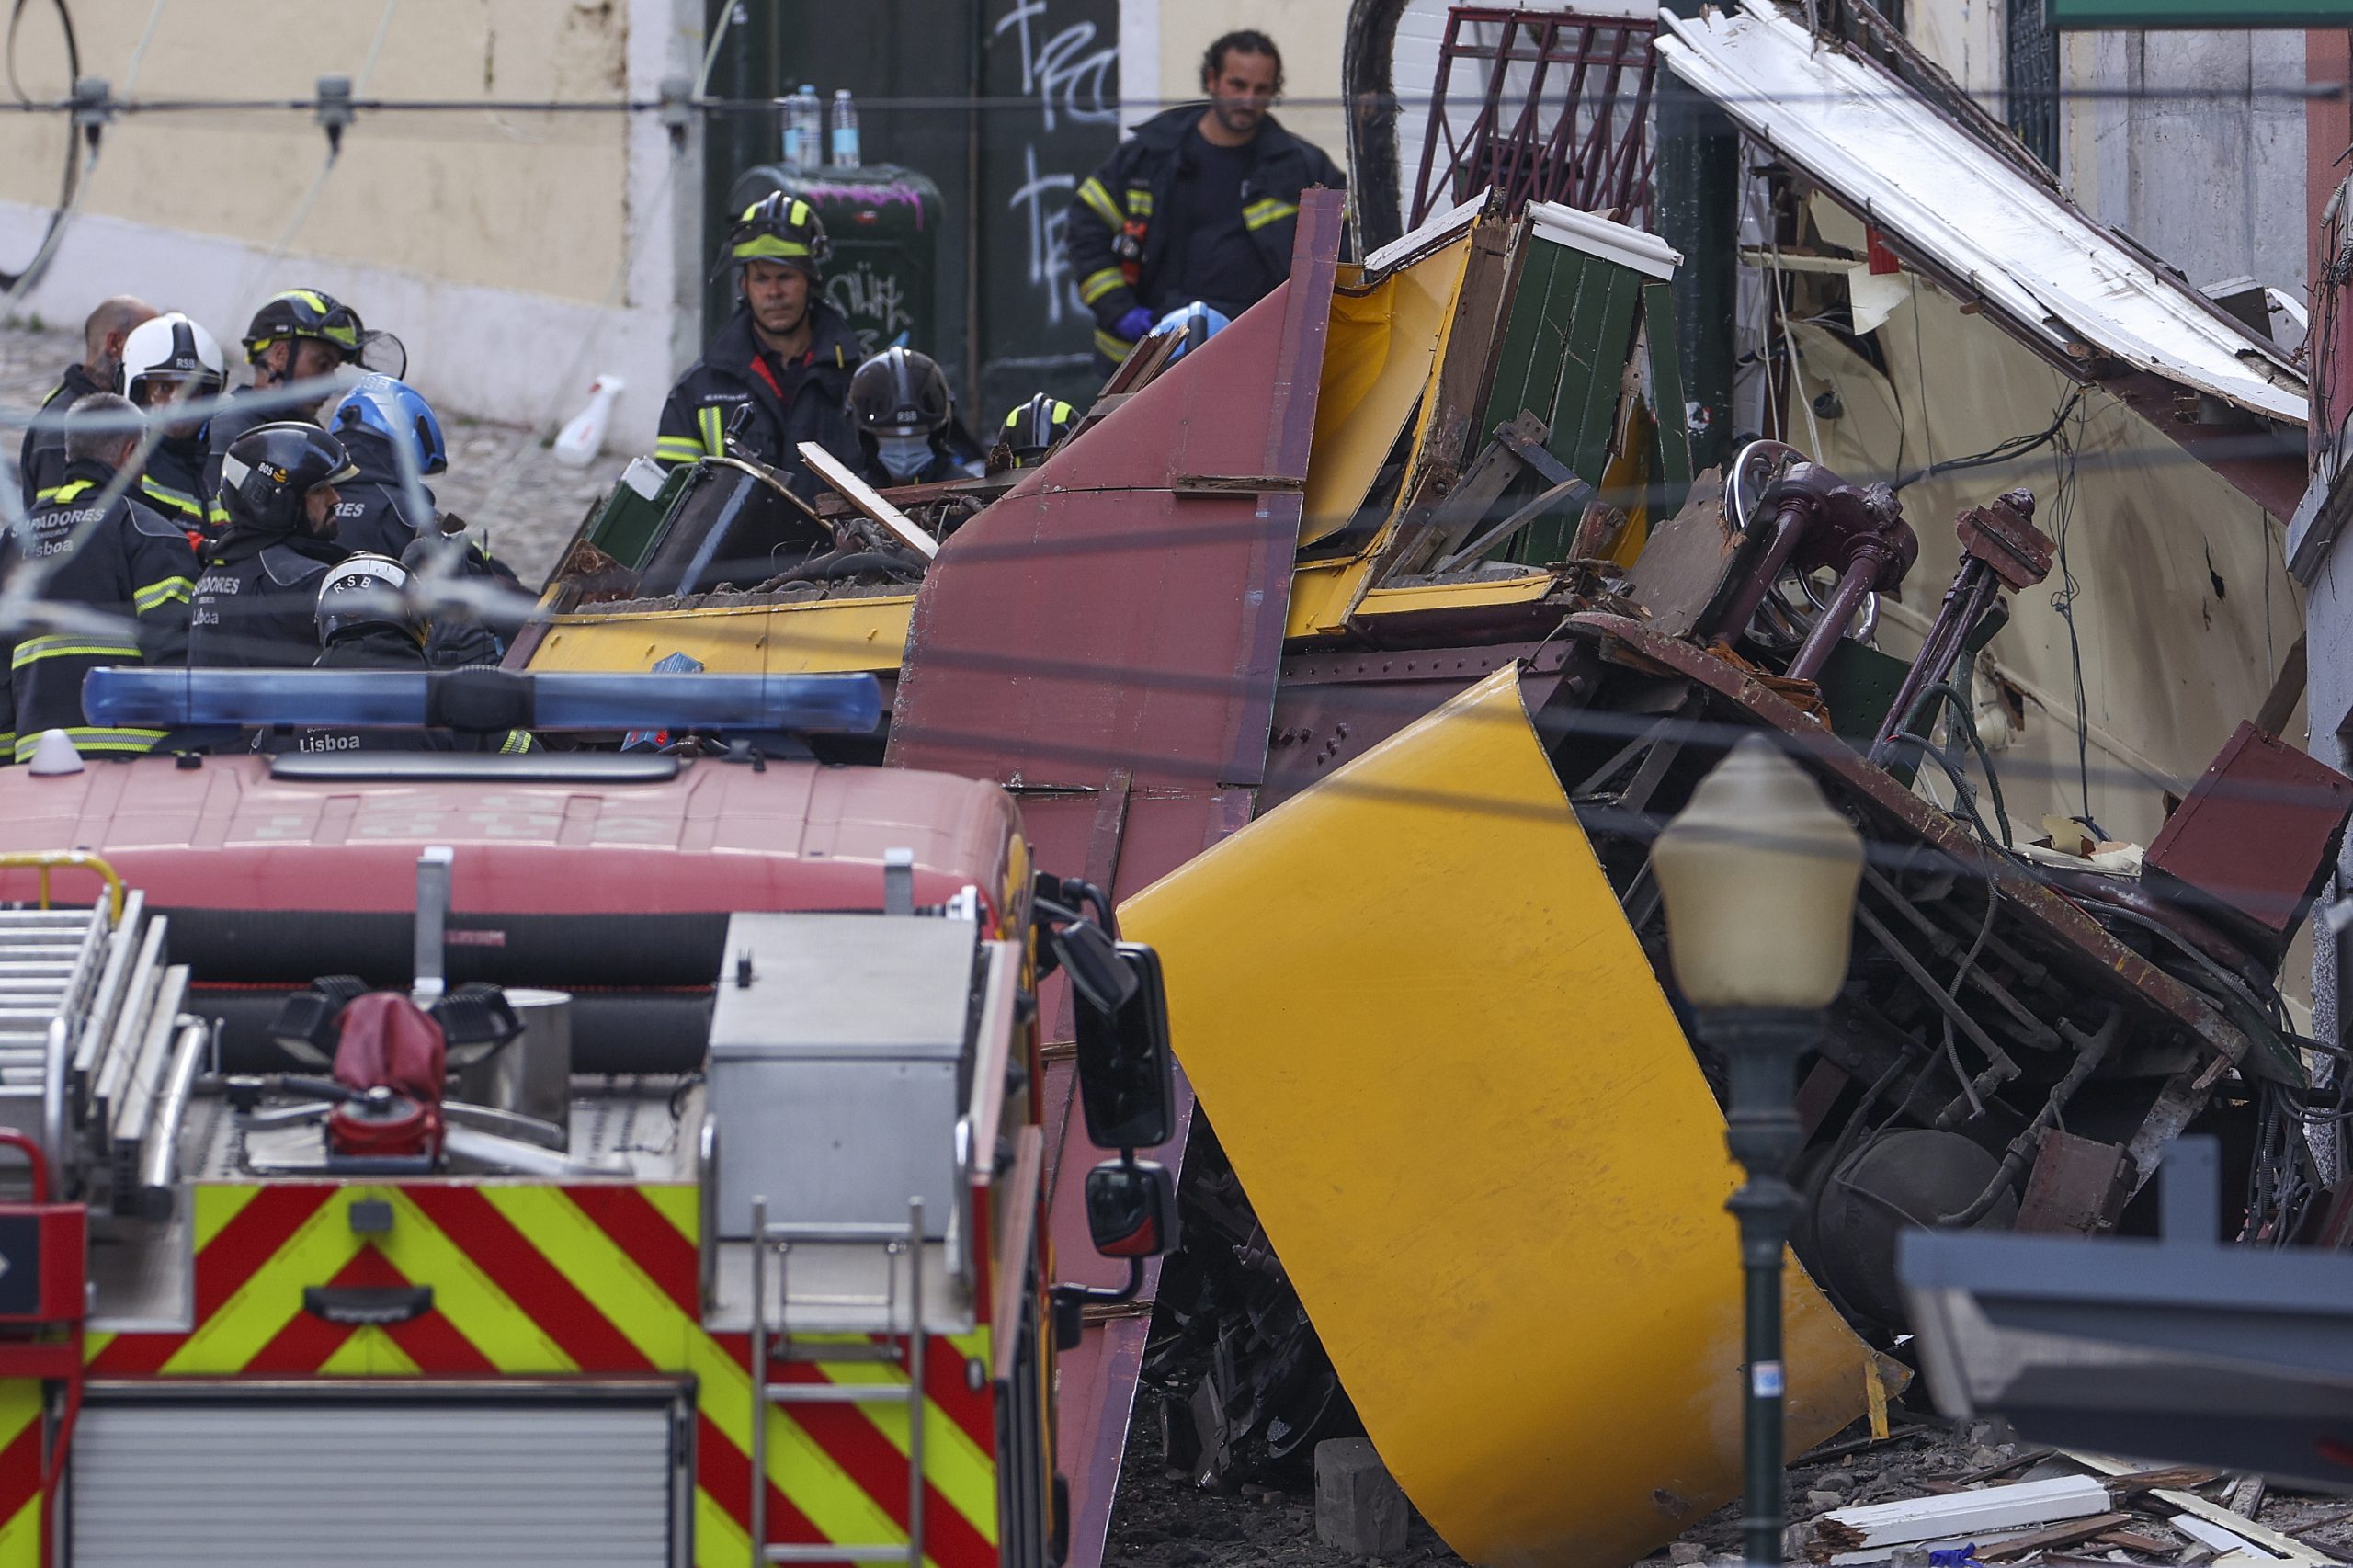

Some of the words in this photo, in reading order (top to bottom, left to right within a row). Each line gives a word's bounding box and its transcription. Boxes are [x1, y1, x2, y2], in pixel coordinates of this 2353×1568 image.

[257, 462, 274, 477] 805
[333, 575, 372, 595] RSB
[299, 734, 360, 753] Lisboa
